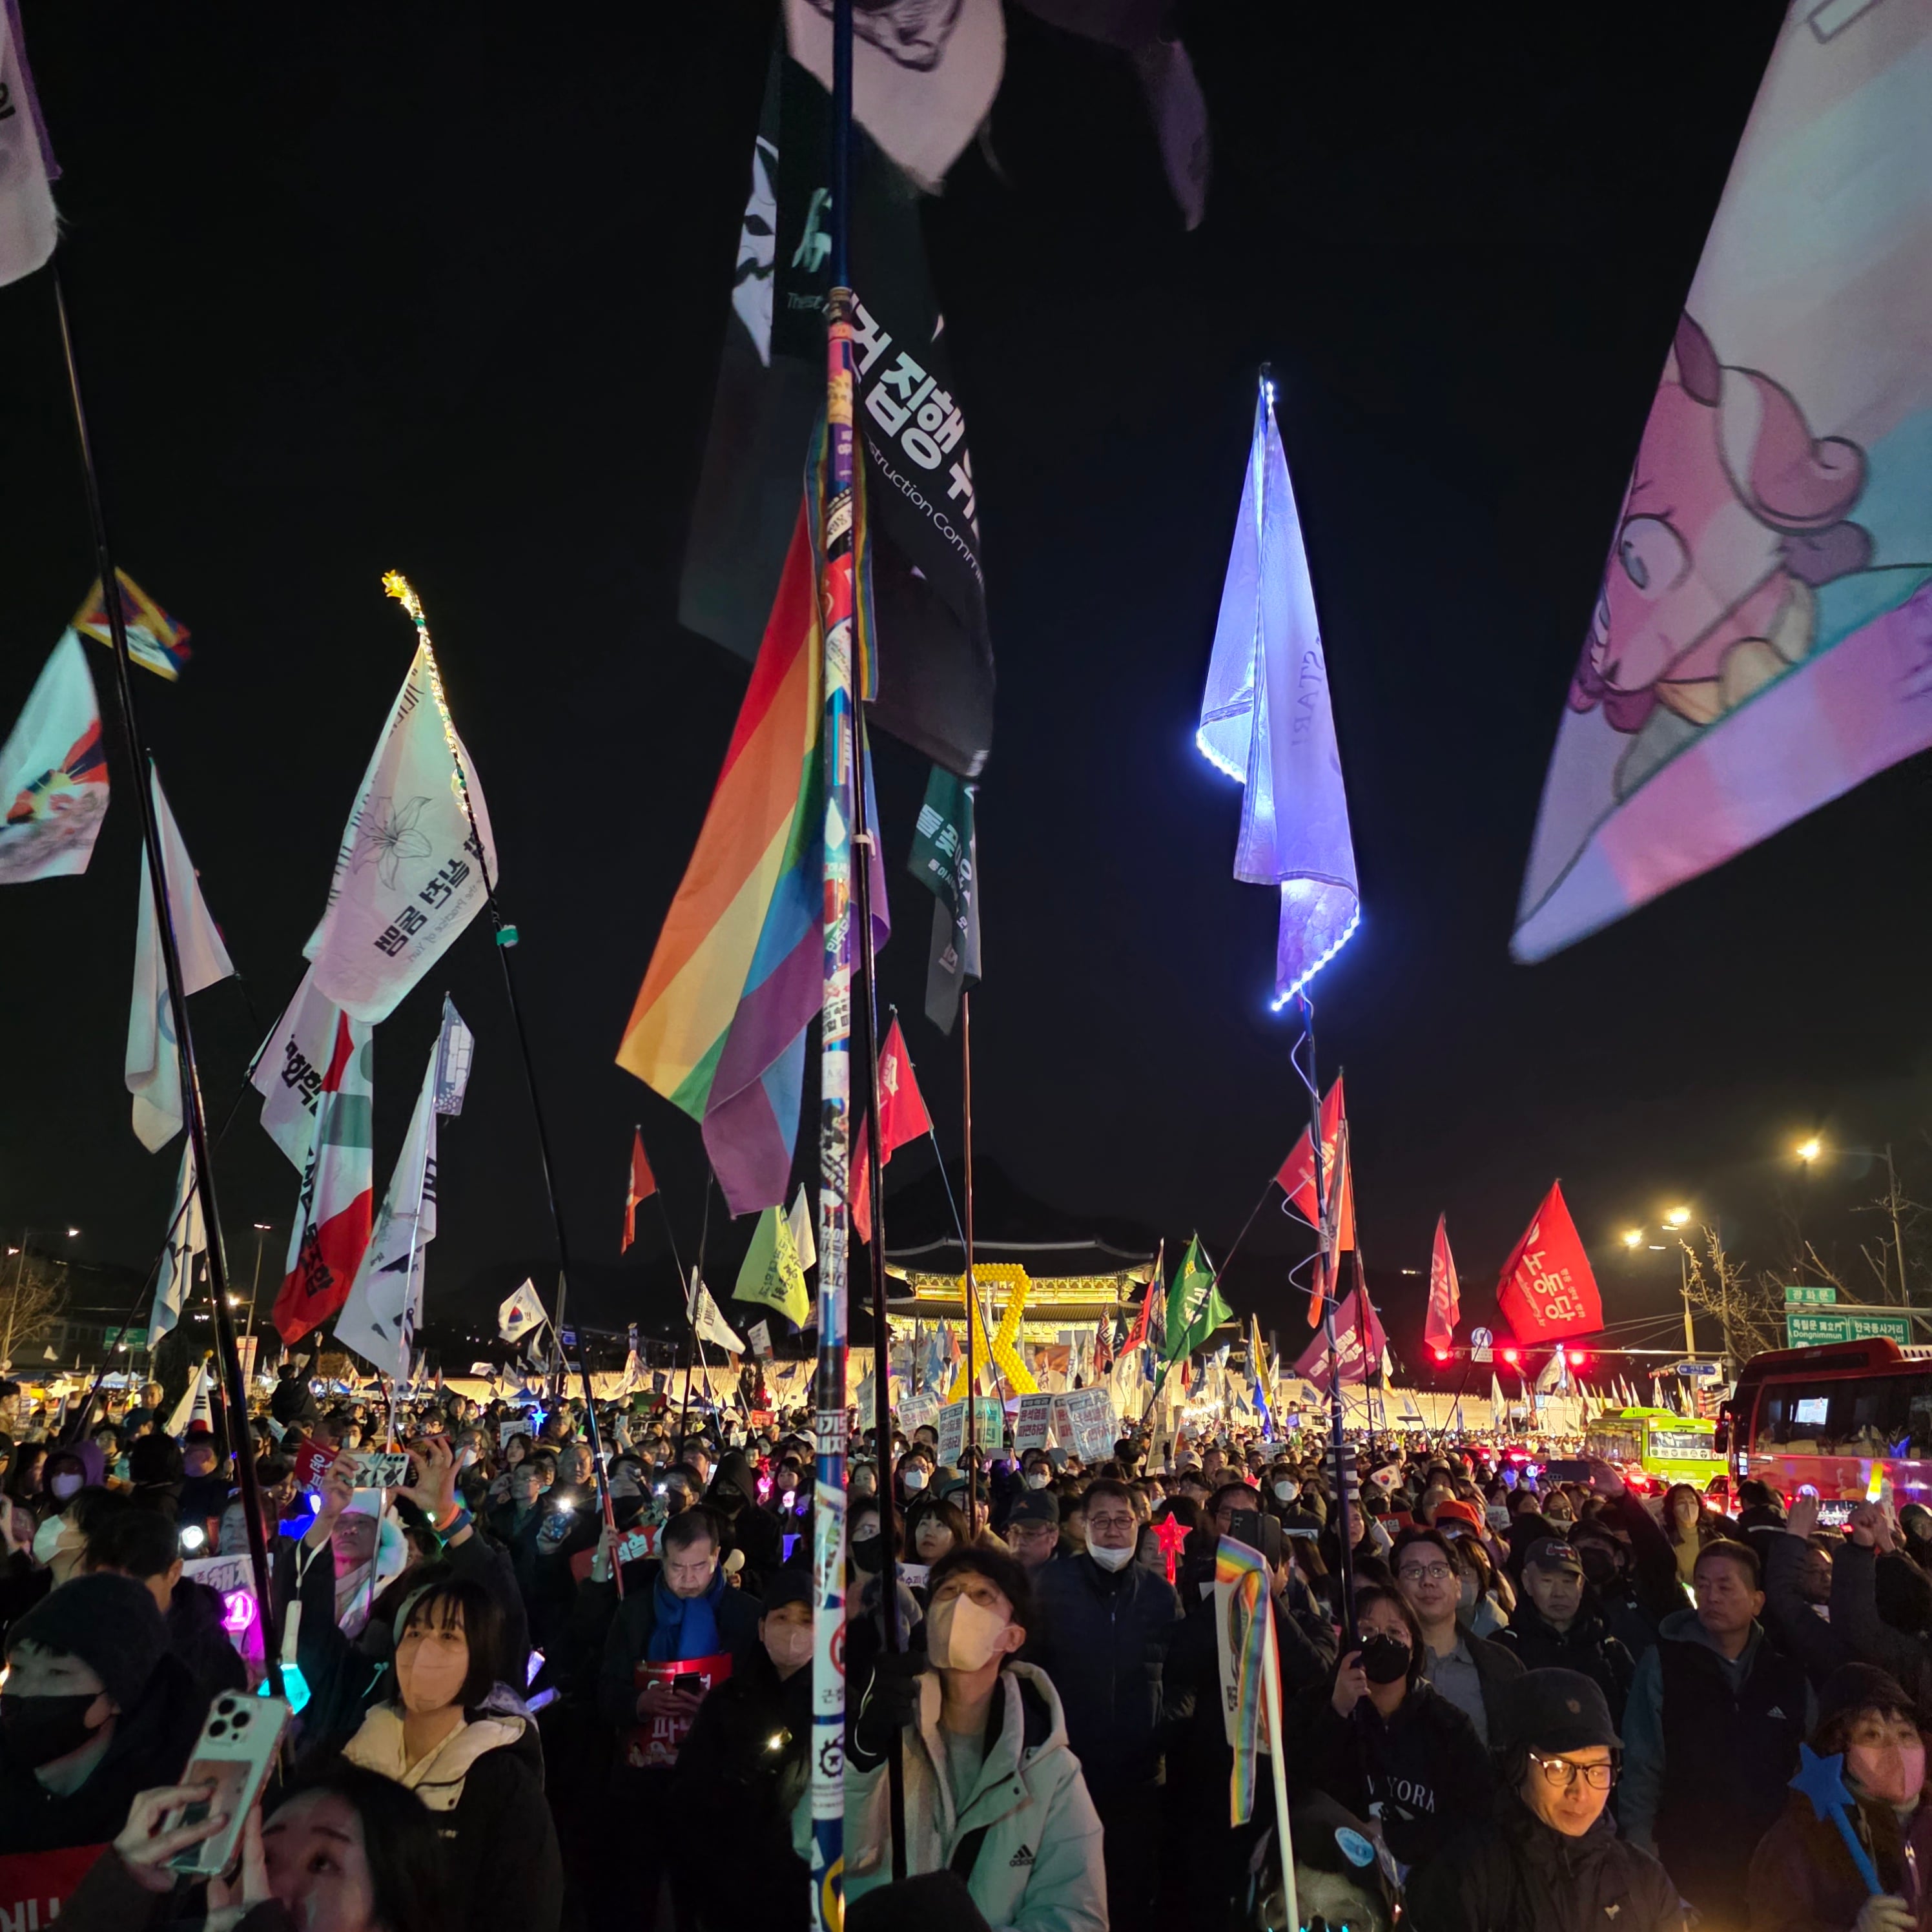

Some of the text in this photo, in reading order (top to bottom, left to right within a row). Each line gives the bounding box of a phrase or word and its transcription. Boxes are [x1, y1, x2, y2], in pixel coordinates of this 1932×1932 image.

[865, 351, 966, 470] 집행
[1522, 1251, 1575, 1322] 노동당
[1793, 1290, 1829, 1300] 광화문
[1793, 1319, 1817, 1330] 독립문
[1793, 1330, 1843, 1341] Dongnimmun
[1020, 1408, 1047, 1422] 윤석열을
[1017, 1423, 1046, 1437] 파면하라
